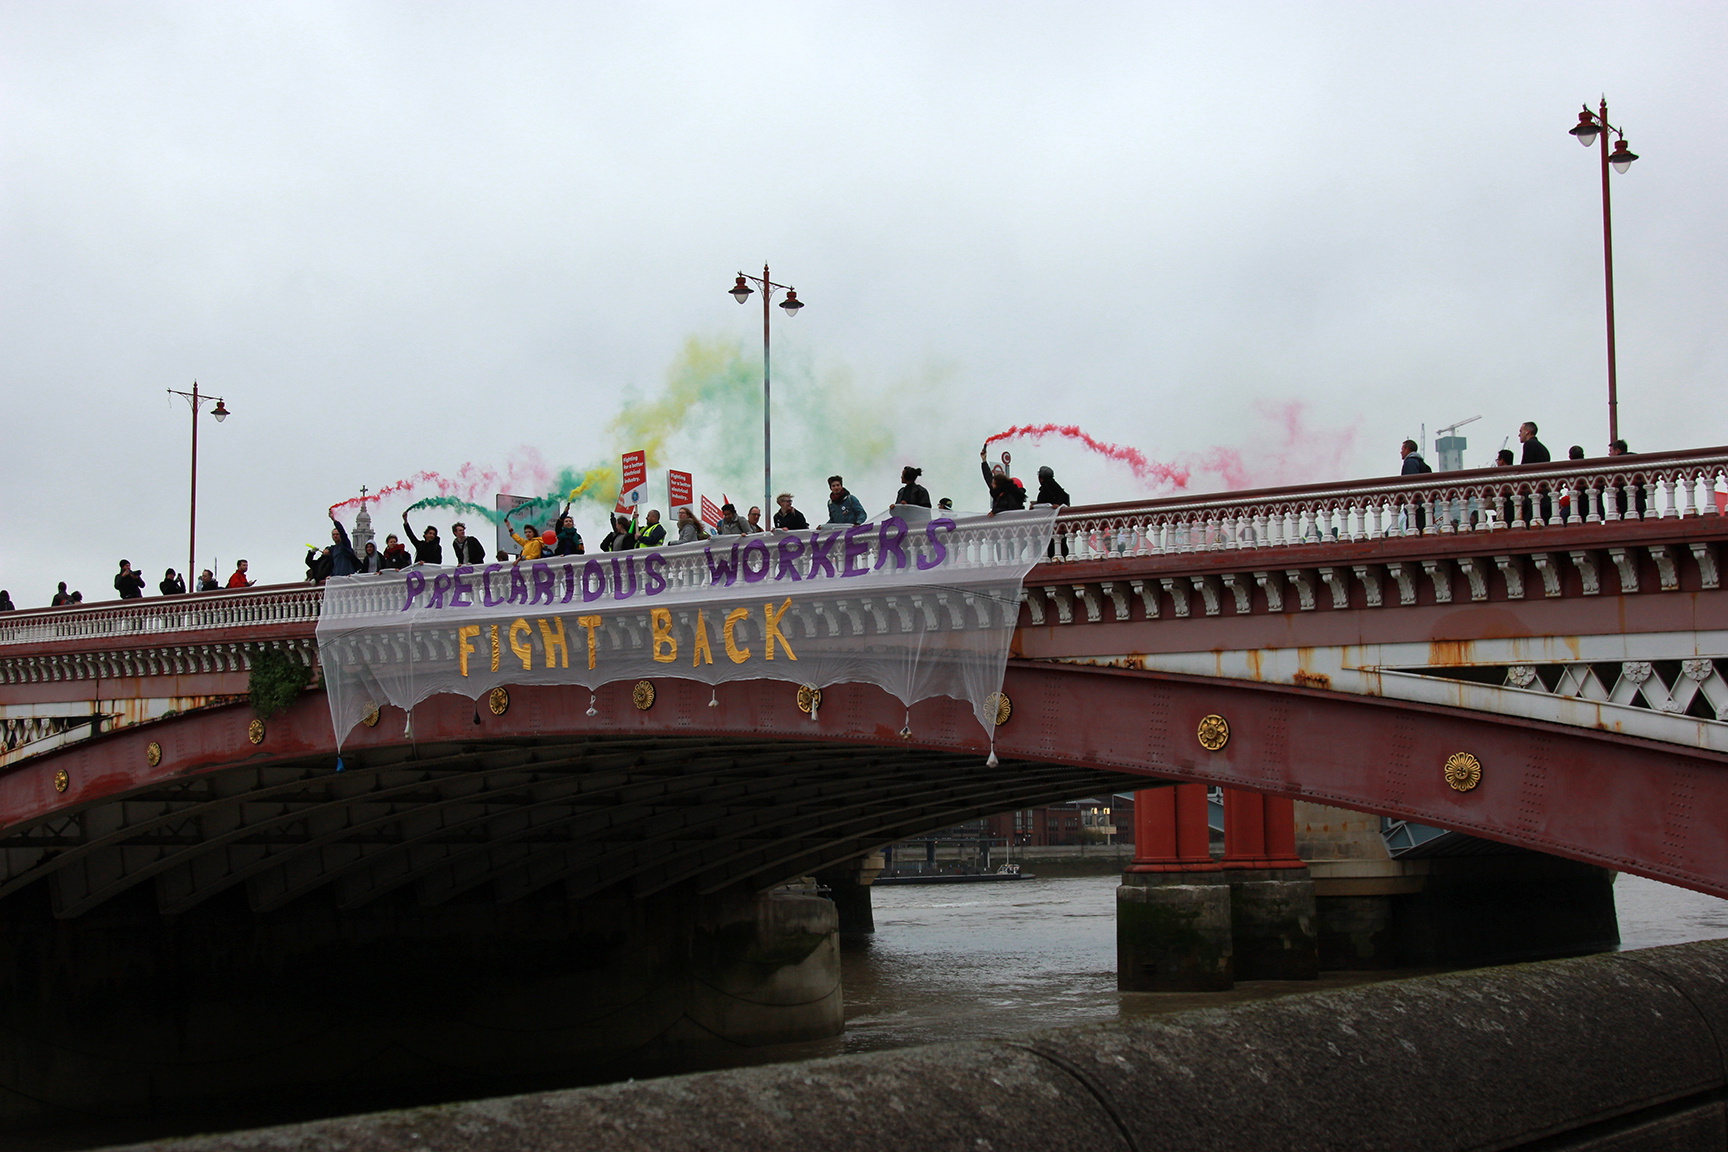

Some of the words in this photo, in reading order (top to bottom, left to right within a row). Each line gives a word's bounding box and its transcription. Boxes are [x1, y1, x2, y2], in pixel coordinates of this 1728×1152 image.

[623, 455, 638, 463] Fighting
[624, 468, 641, 477] electrical
[671, 473, 686, 481] Fighting
[672, 486, 688, 494] electrical
[704, 516, 957, 587] WORKERS
[458, 615, 602, 677] FIGHT
[650, 597, 798, 667] BACK
